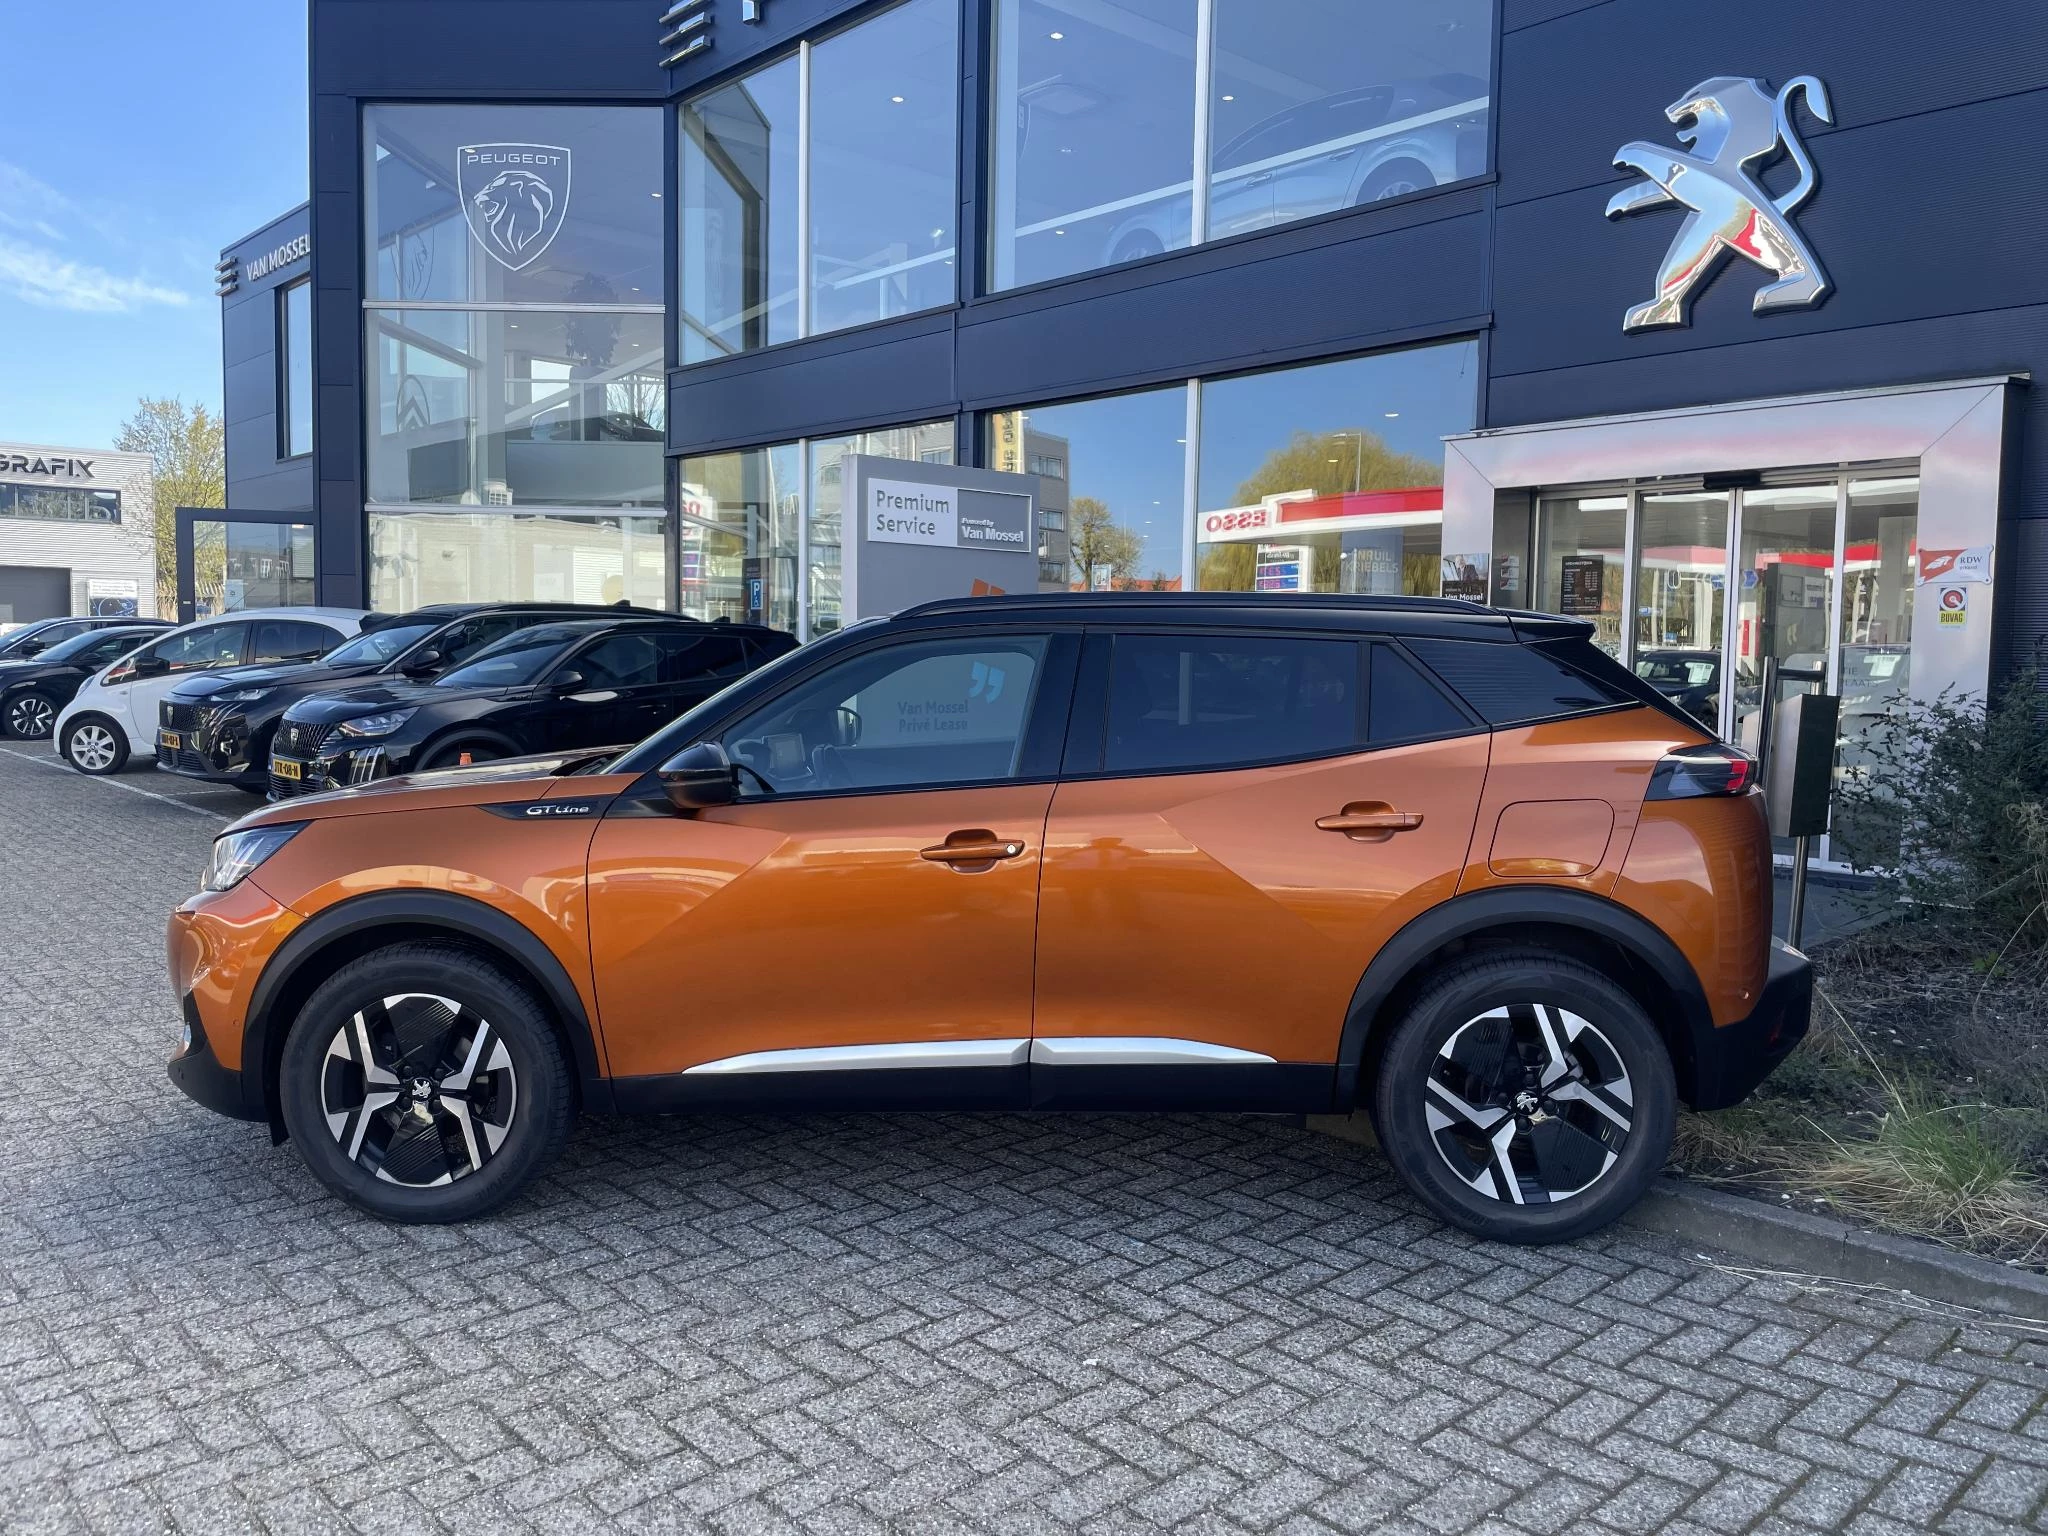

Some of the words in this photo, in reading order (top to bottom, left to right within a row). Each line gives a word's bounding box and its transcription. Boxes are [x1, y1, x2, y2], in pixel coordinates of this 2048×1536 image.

[467, 153, 560, 165] PEUGEOT
[246, 256, 268, 281] VAN
[268, 233, 310, 271] MOSSEL
[876, 489, 950, 513] Premium
[876, 514, 936, 536] Service
[961, 525, 983, 540] Van
[985, 528, 1025, 543] Mossel
[1960, 556, 1983, 564] RDW
[1460, 592, 1484, 602] Mossel
[897, 701, 922, 715] Van
[926, 699, 969, 714] Mossel
[898, 717, 930, 732] Privé
[934, 718, 968, 731] Lease
